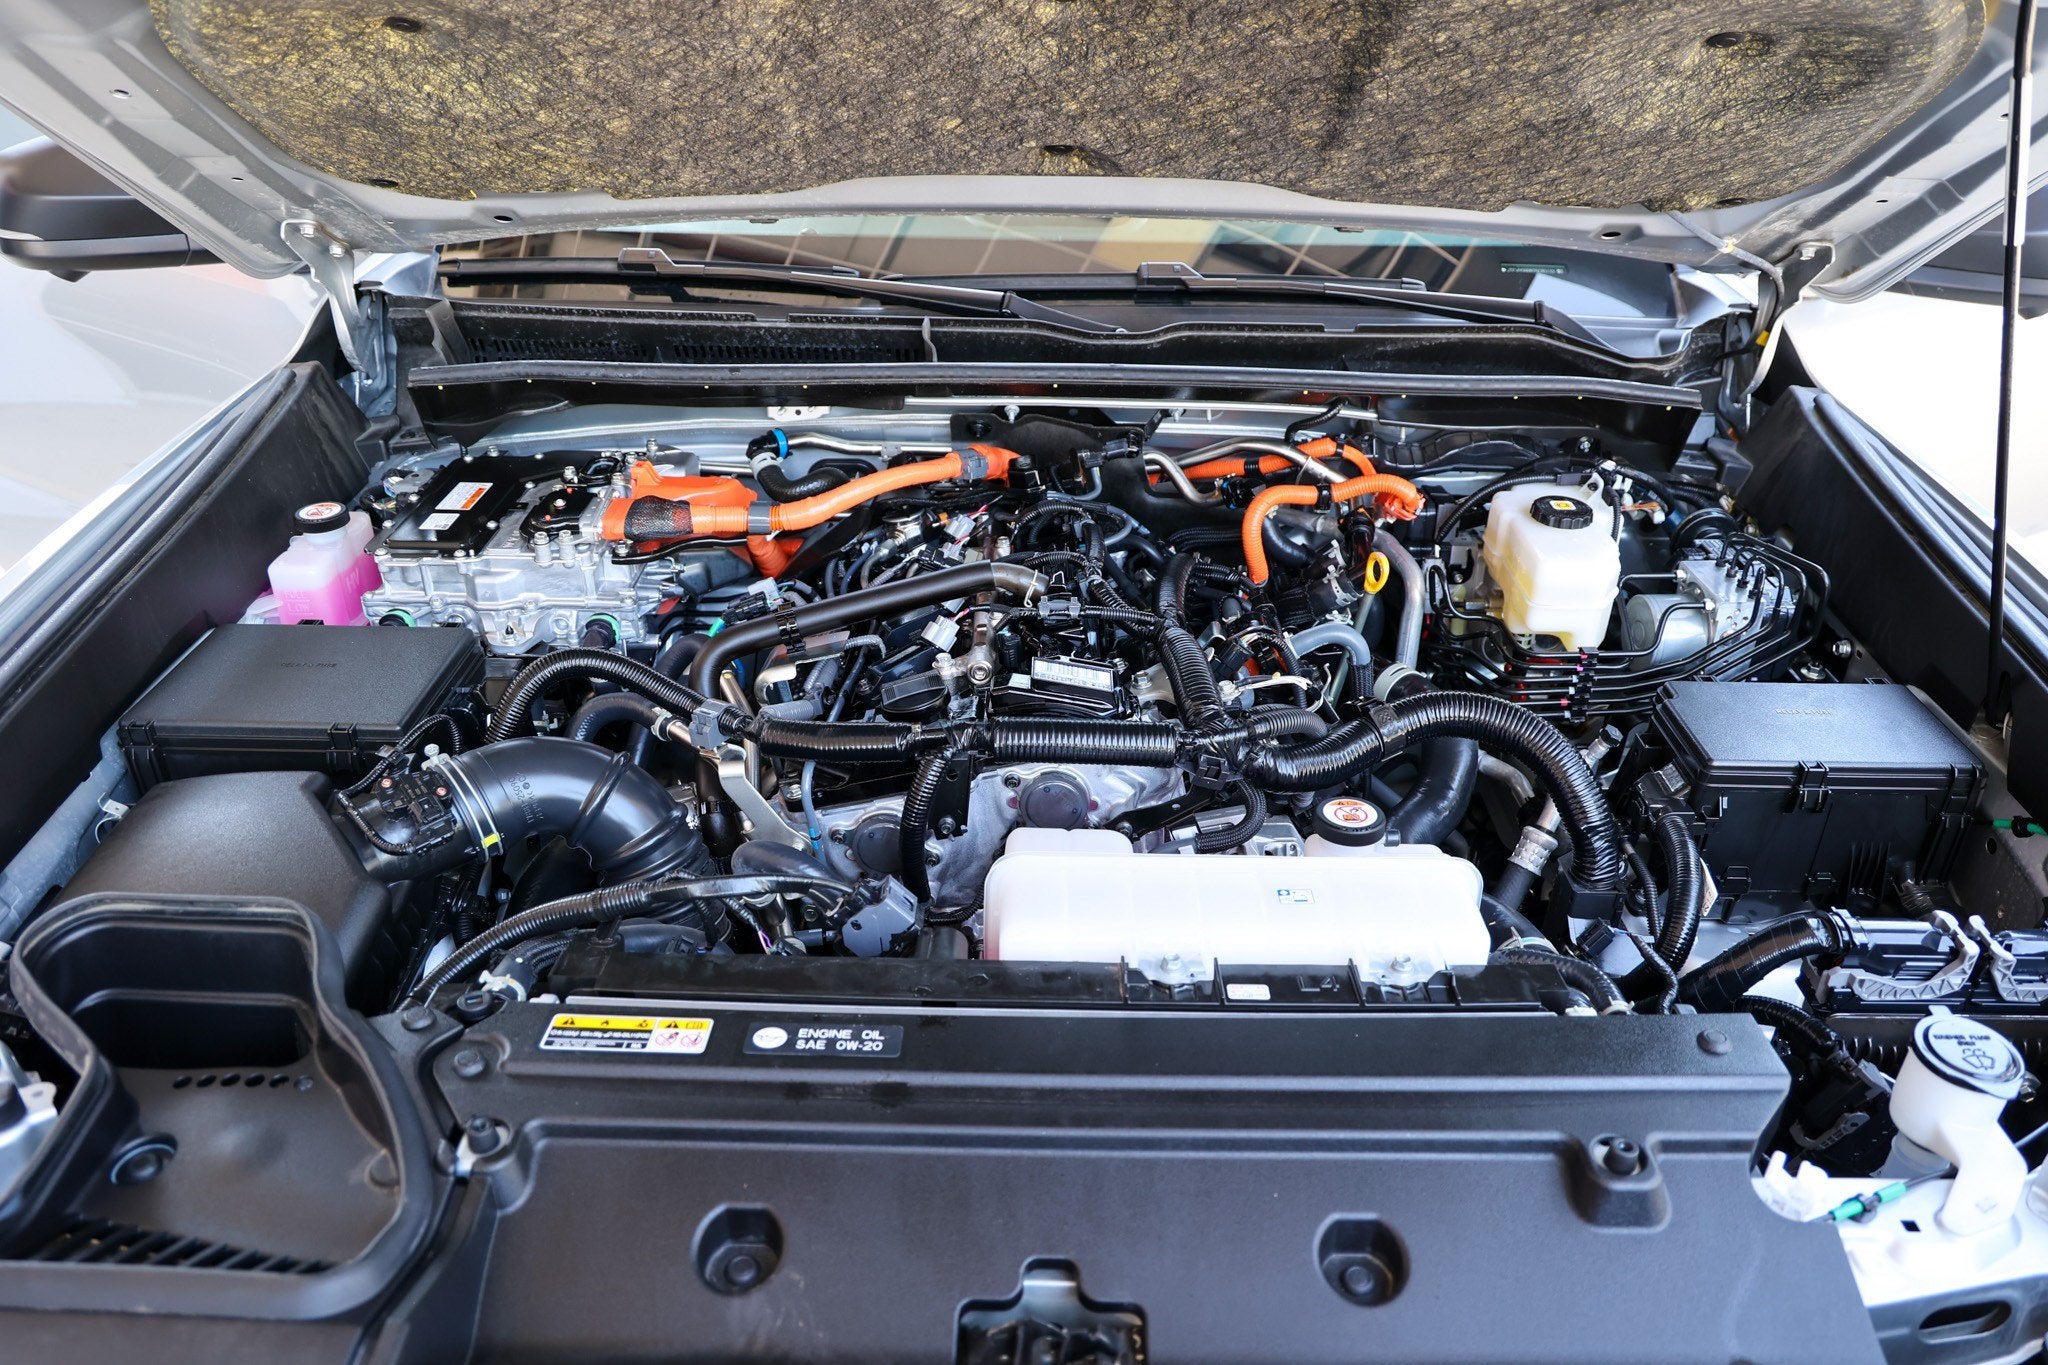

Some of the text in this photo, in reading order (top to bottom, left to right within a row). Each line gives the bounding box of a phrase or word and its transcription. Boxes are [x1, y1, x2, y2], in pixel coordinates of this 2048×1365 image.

[1297, 975, 1340, 992] L4
[797, 1028, 885, 1040] ENGINE OIL
[795, 1039, 883, 1051] SAE 0W-20
